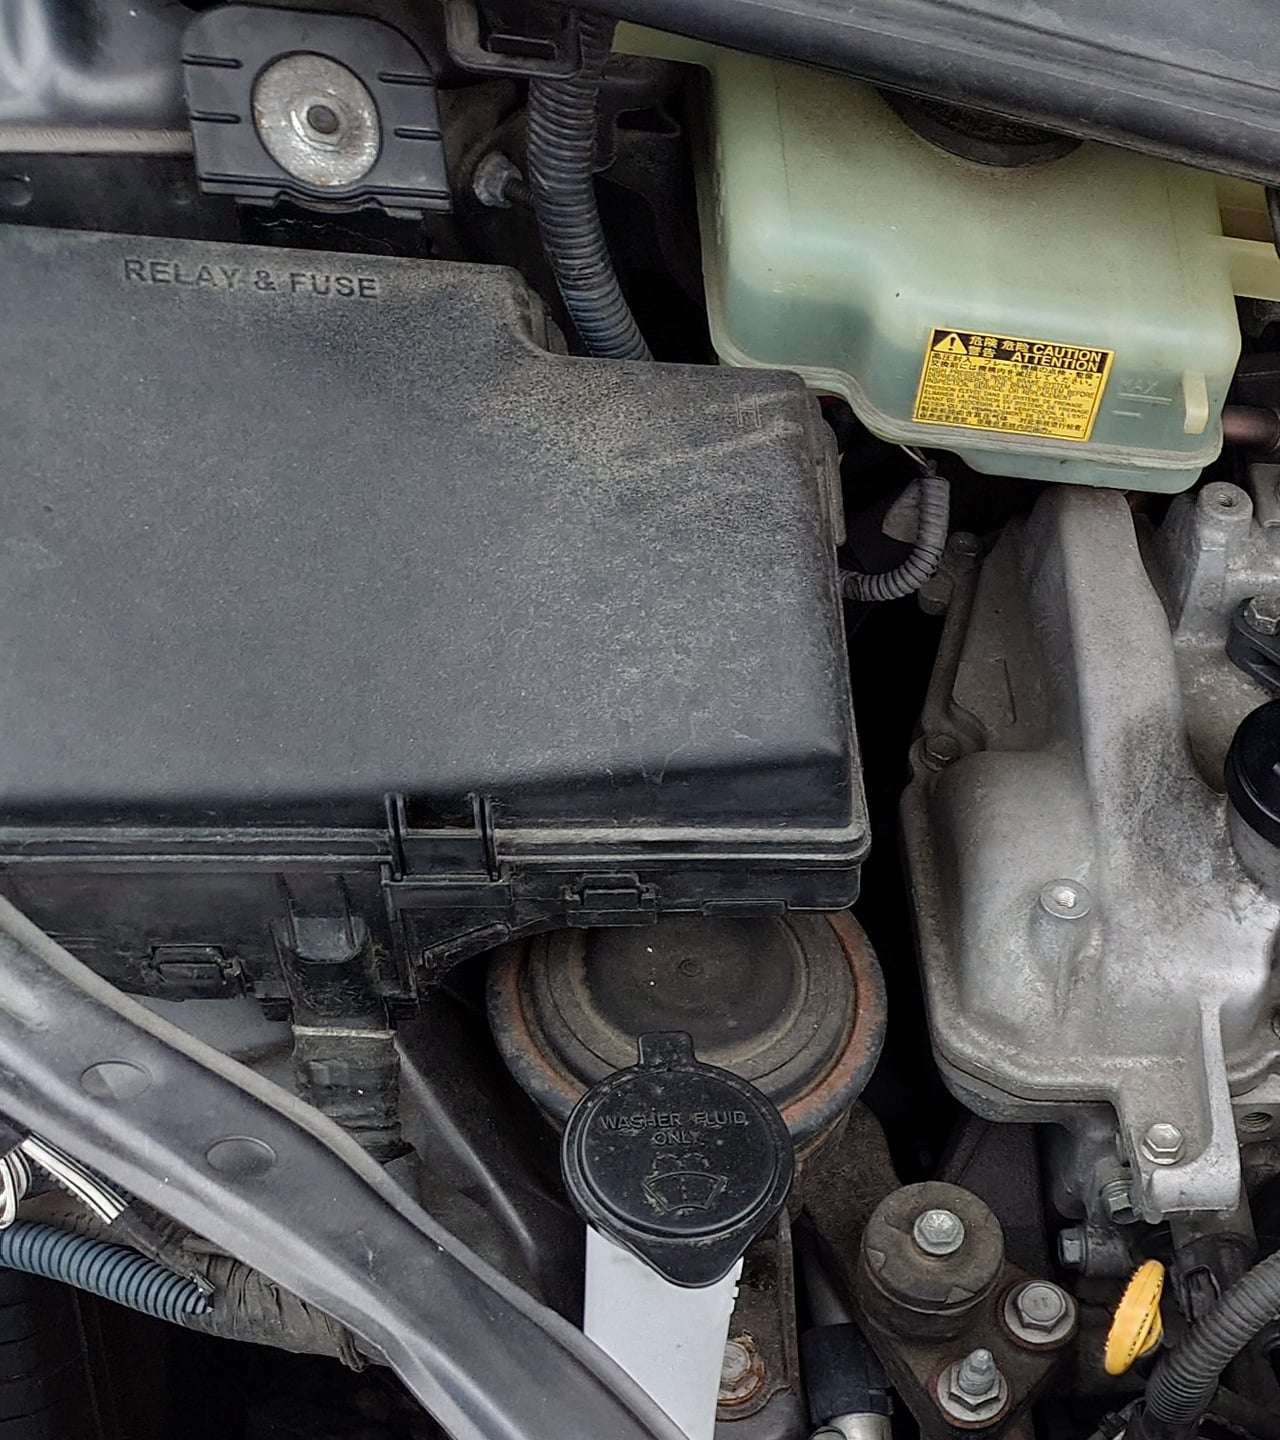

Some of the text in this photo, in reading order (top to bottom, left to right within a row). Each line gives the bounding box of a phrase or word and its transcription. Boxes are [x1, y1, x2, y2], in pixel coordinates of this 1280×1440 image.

[123, 259, 378, 298] RELAY & FUSE
[1011, 352, 1099, 372] ATTENTION
[1033, 344, 1102, 363] CAUTION
[600, 1110, 748, 1130] WASHER FLUID
[653, 1130, 701, 1146] ONLY
